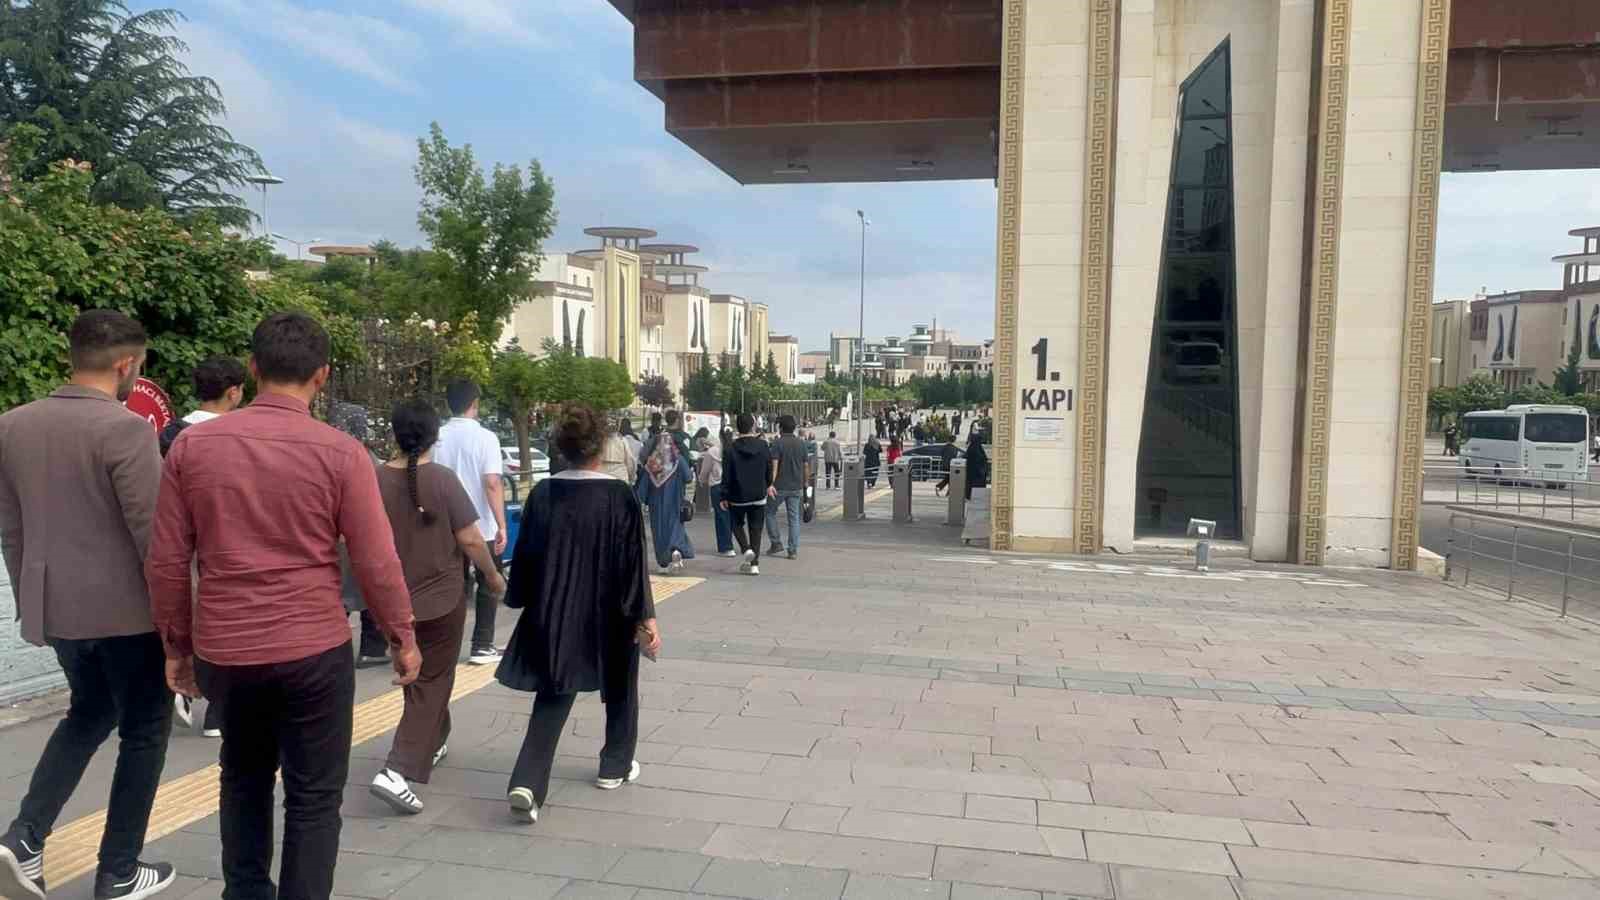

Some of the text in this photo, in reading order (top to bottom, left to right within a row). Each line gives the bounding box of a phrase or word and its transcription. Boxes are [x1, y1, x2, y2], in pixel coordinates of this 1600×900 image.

[1031, 338, 1060, 381] 1.
[154, 395, 171, 428] BEKTA
[1021, 388, 1073, 411] KAPI
